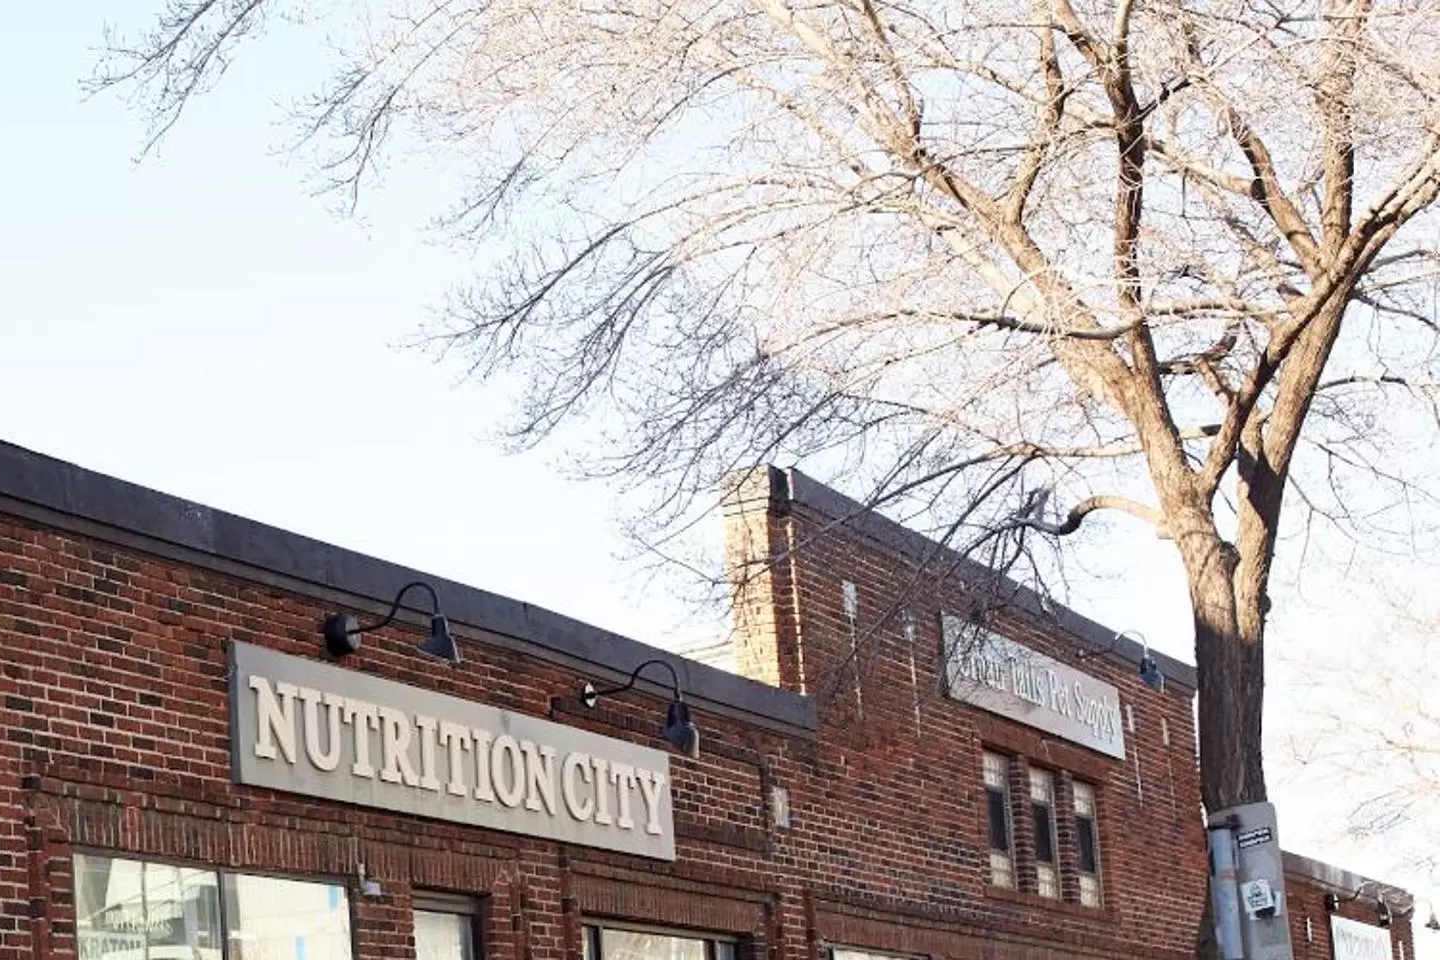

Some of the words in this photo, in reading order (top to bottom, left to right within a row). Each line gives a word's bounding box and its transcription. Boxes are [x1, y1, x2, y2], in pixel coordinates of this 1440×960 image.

[248, 675, 558, 815] NUTRITION
[561, 751, 665, 835] CITY
[1073, 680, 1116, 744] Supply
